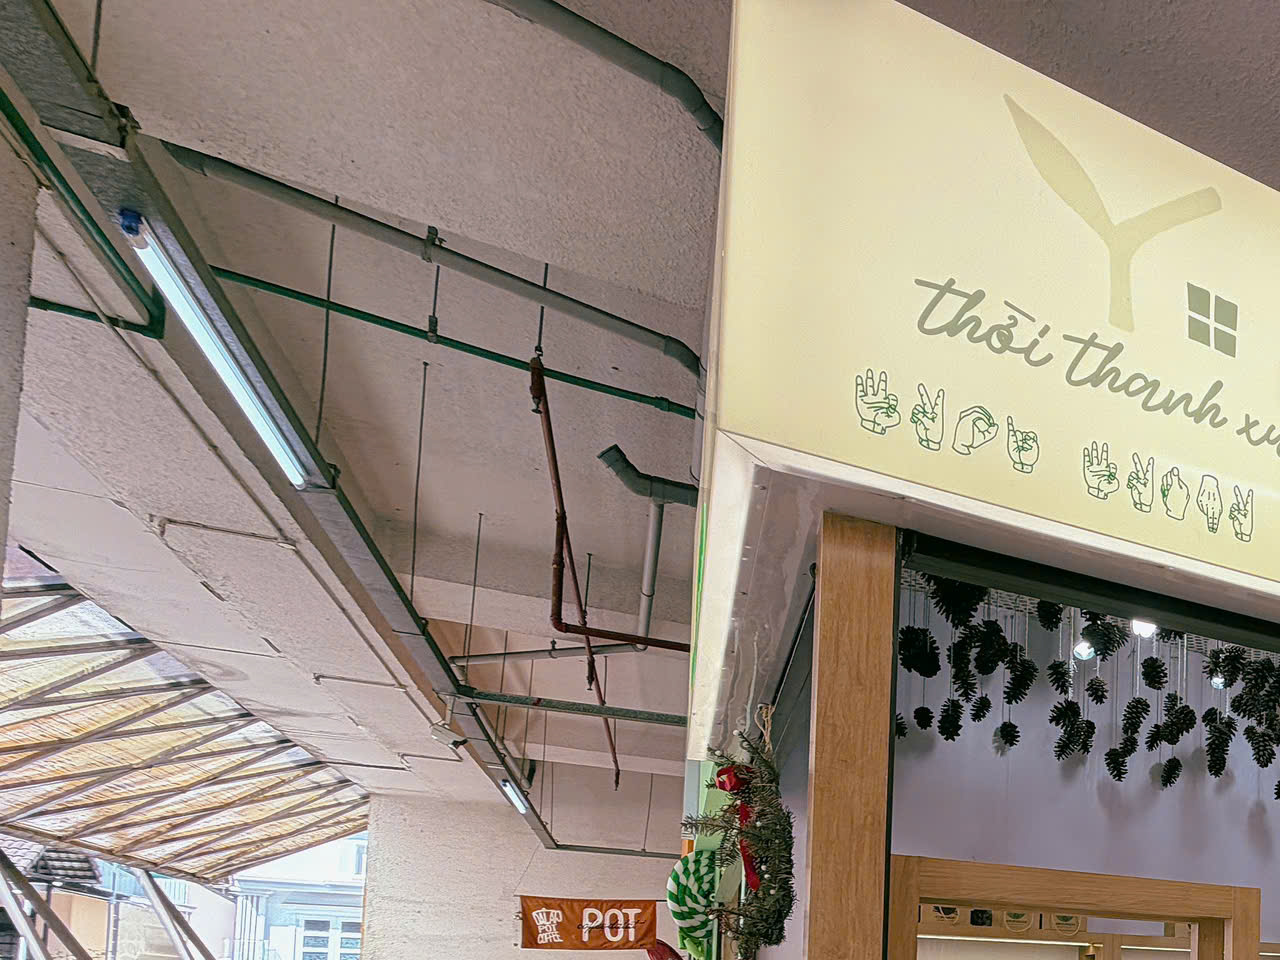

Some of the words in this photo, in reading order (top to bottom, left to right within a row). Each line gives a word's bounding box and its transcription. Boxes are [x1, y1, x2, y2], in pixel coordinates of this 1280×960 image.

[1062, 331, 1229, 428] thanh
[537, 923, 558, 934] POT
[581, 907, 642, 942] POT
